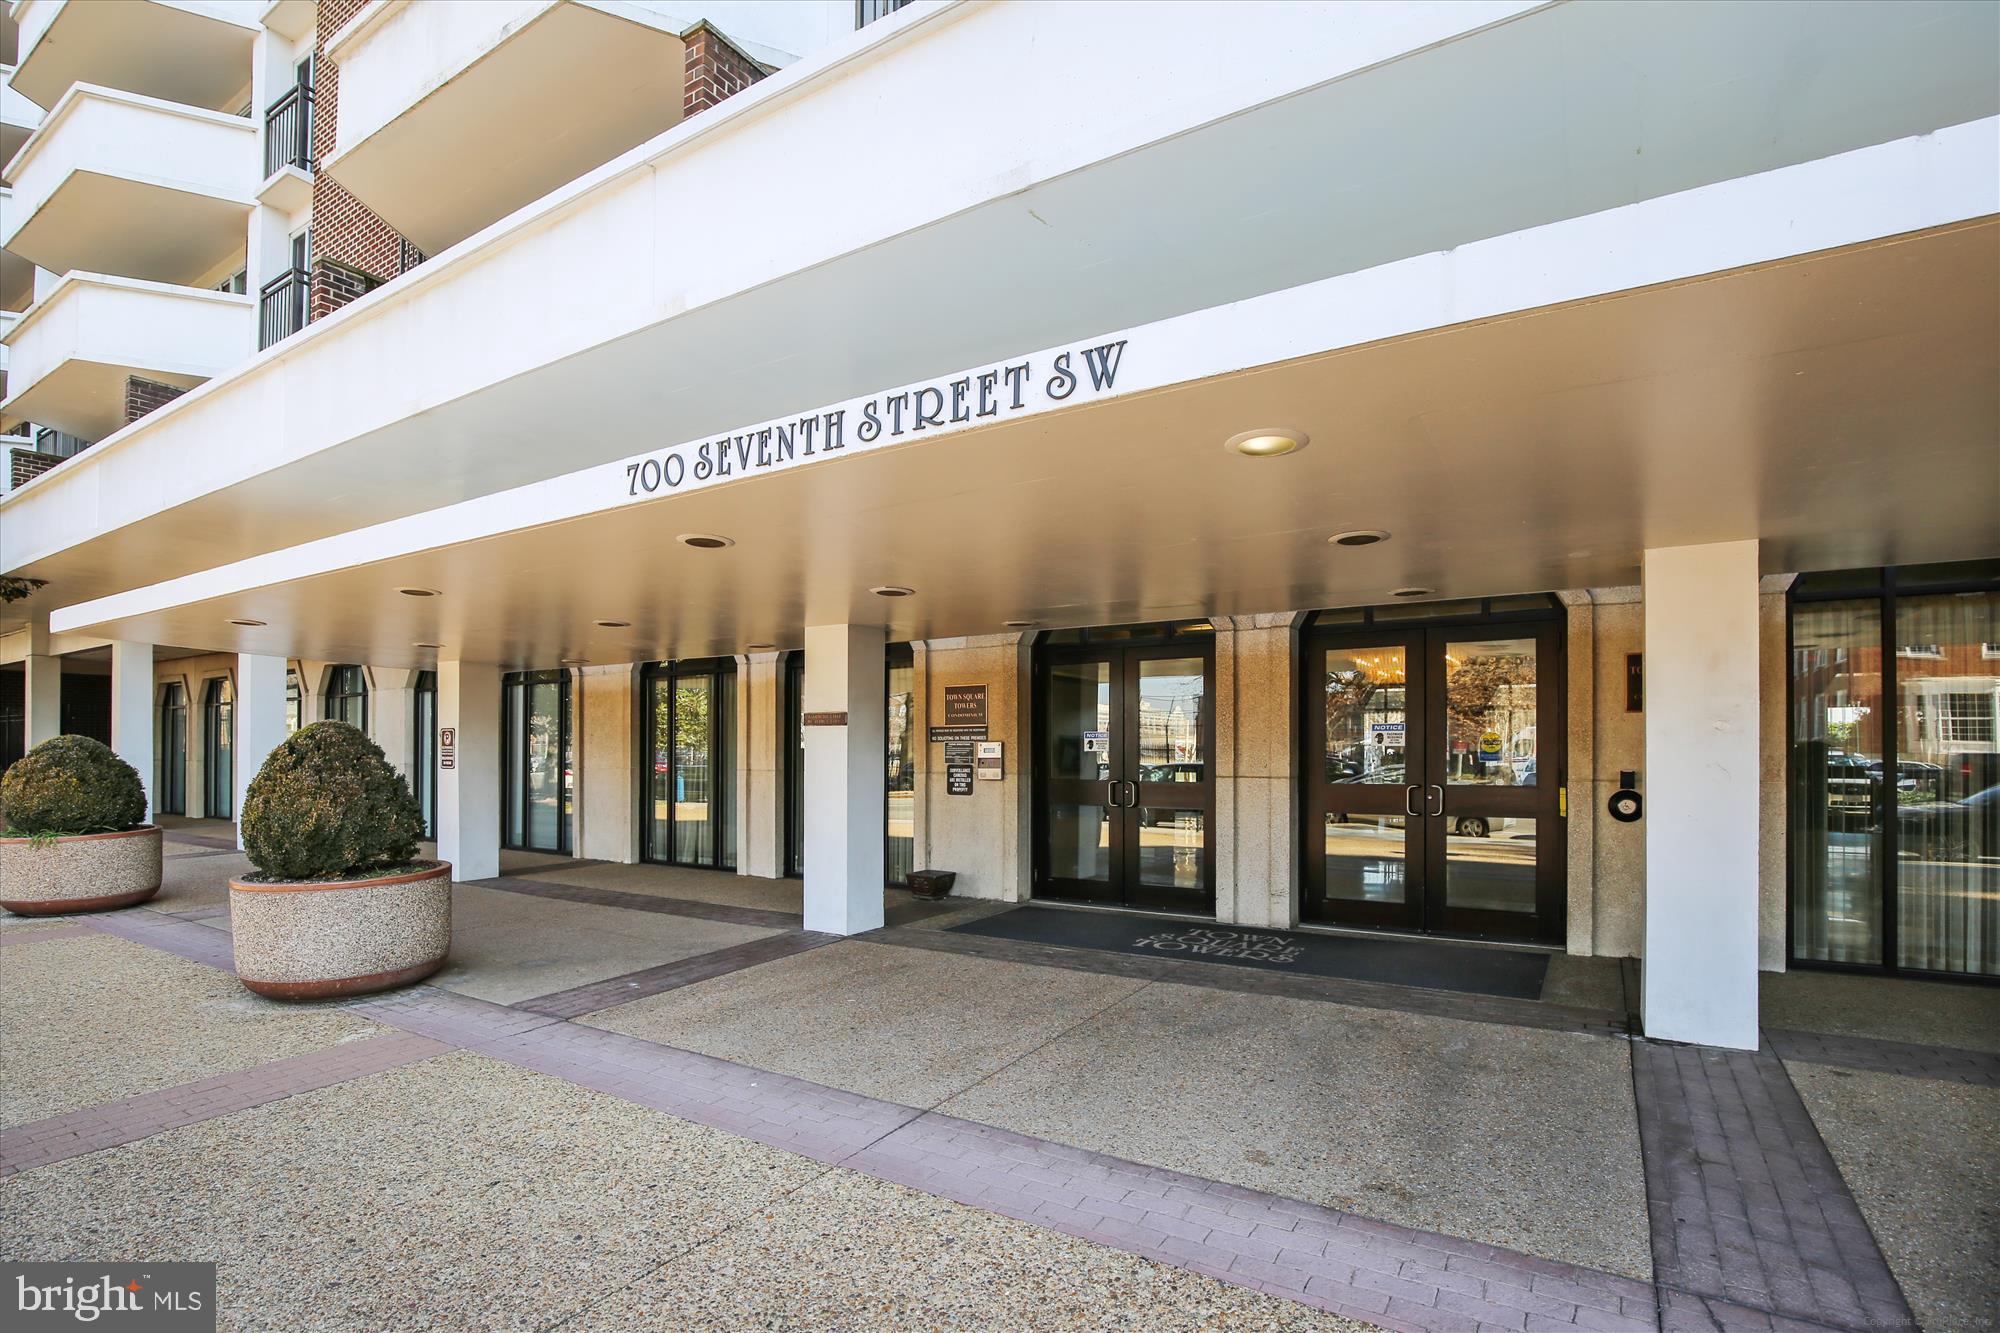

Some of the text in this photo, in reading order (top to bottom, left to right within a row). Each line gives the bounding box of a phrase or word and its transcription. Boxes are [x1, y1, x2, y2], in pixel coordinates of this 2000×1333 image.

[627, 453, 684, 495] 700
[694, 410, 846, 480] SEVENTH
[857, 362, 1030, 442] STREET
[963, 693, 985, 701] SQUARE
[1149, 932, 1305, 956] SQUARE
[1189, 928, 1295, 946] TOWN
[1132, 937, 1295, 963] TOWERS
